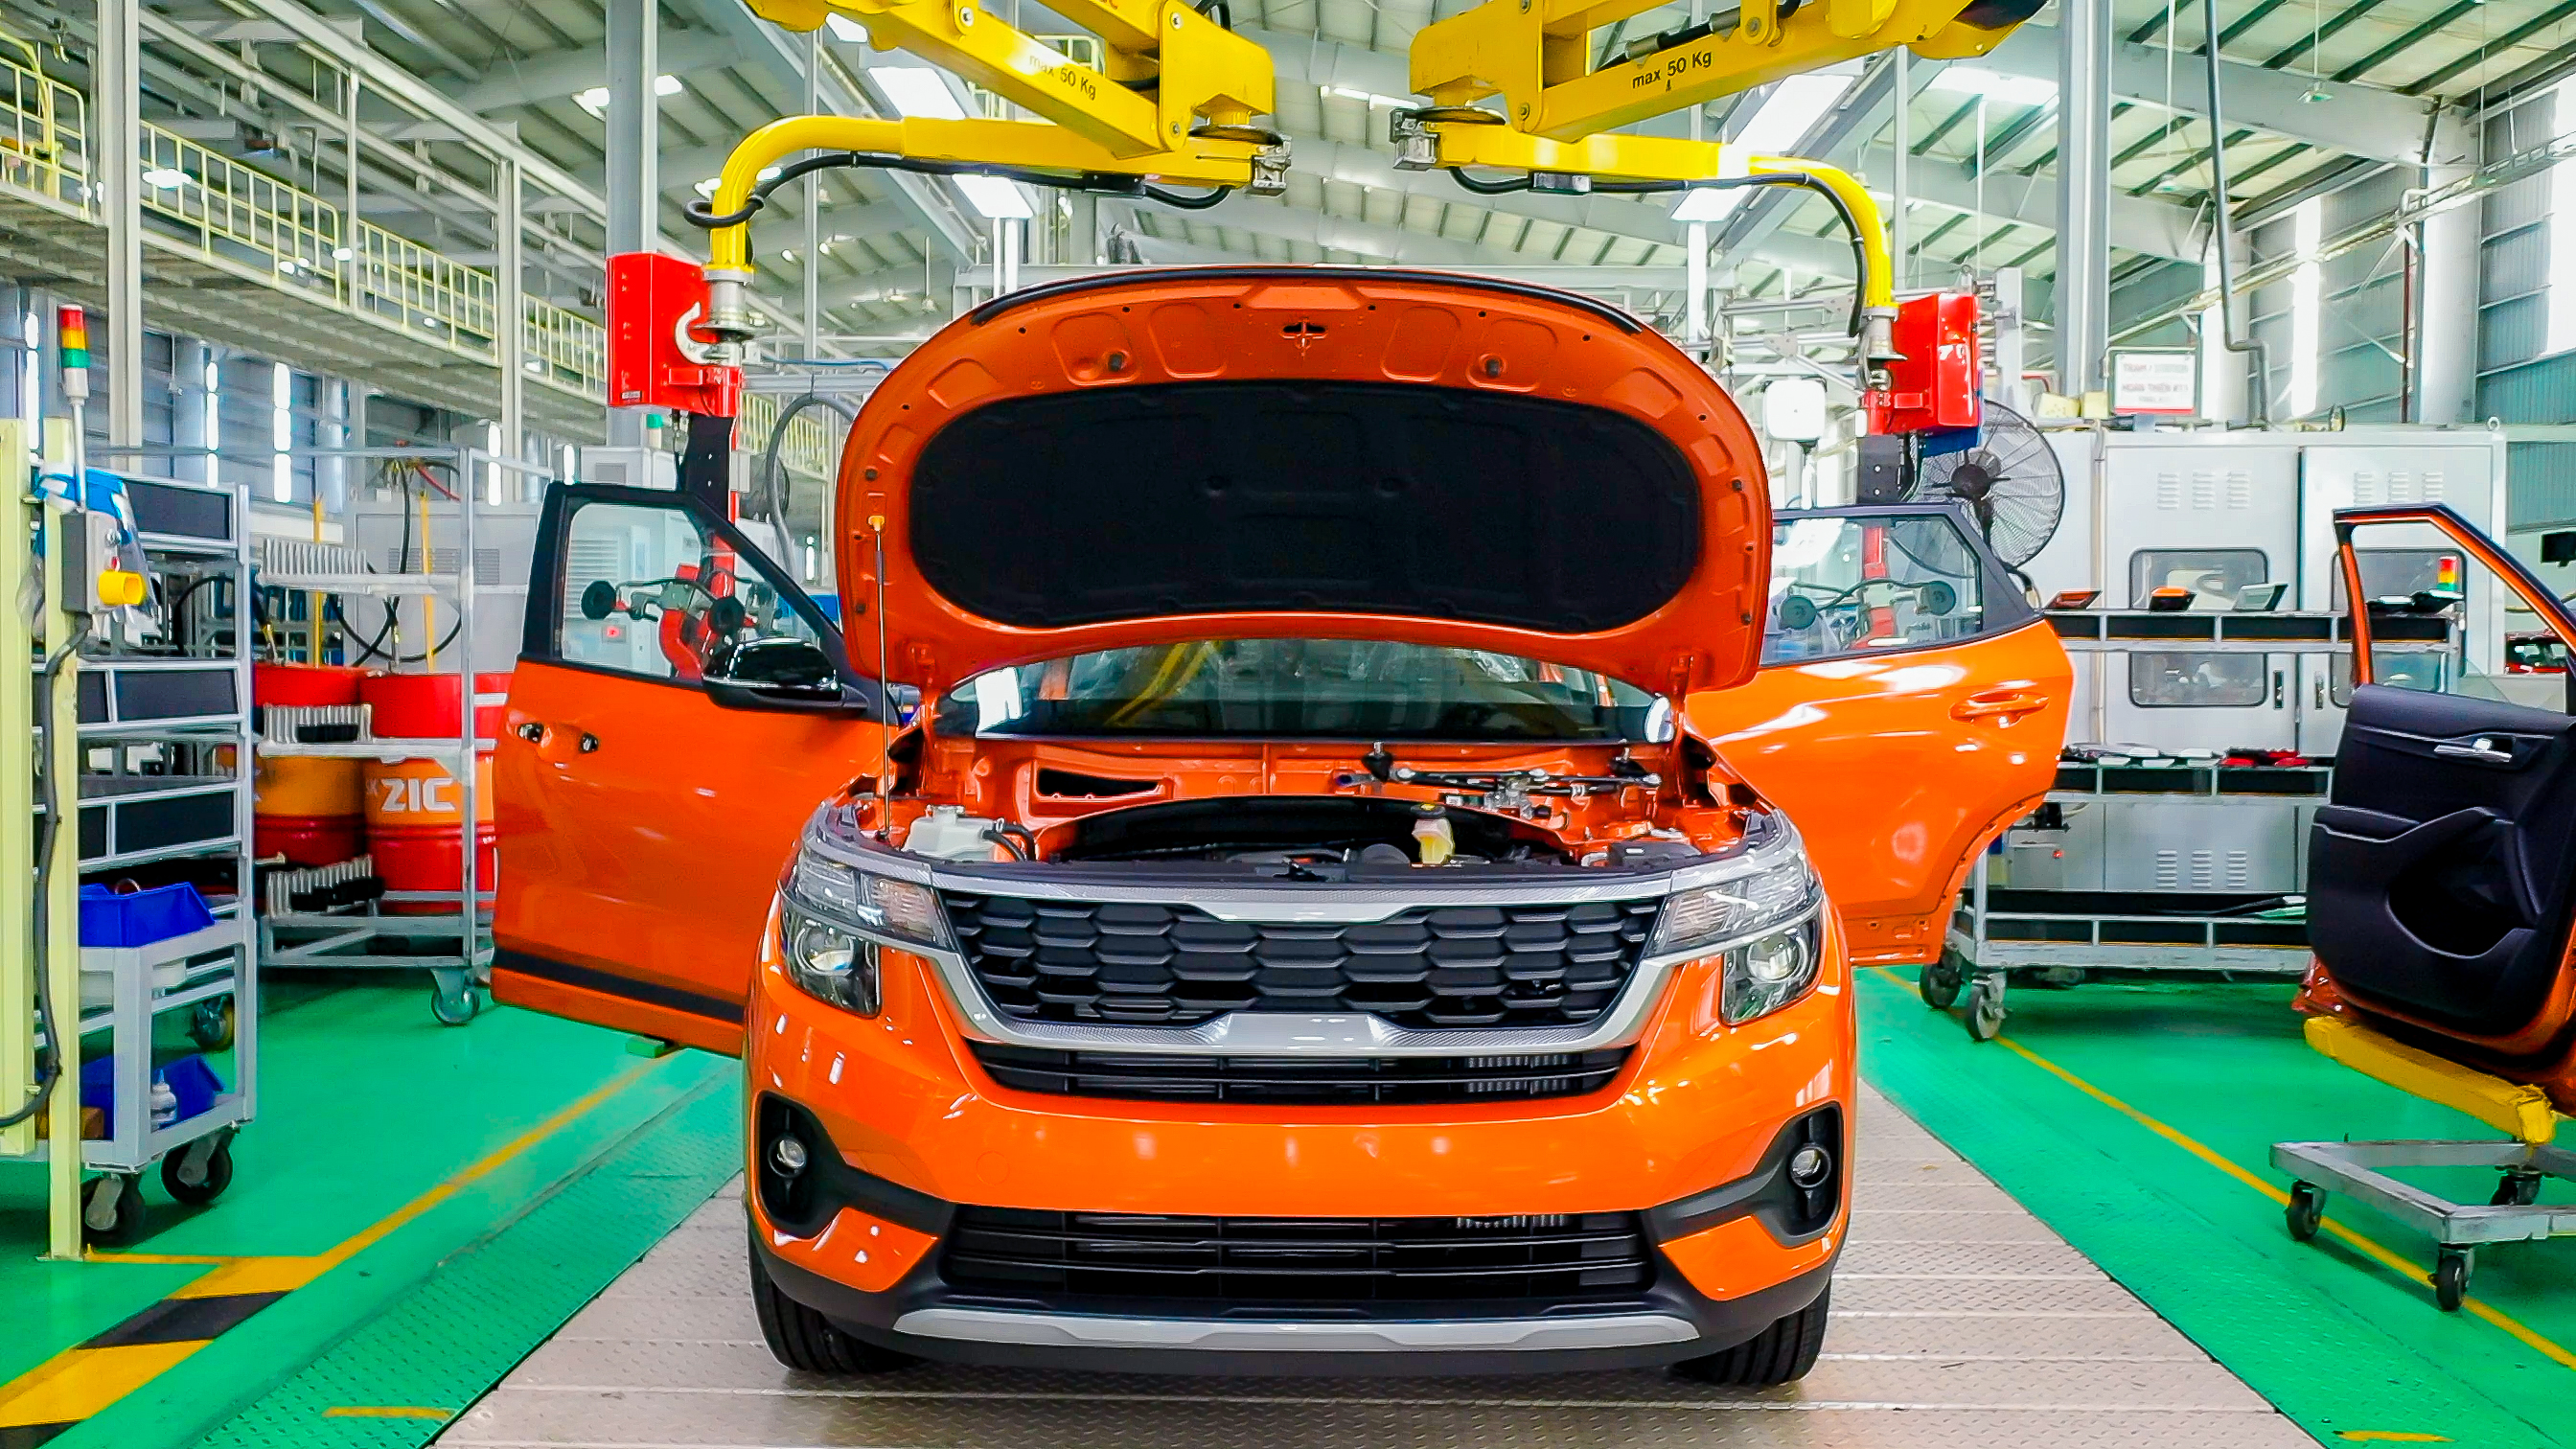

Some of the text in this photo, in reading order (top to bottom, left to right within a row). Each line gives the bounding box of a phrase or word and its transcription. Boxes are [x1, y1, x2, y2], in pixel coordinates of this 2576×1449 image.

[1029, 55, 1096, 101] max 50 Kg
[1631, 51, 1712, 89] max 50 Kg
[380, 777, 455, 813] ZIC
